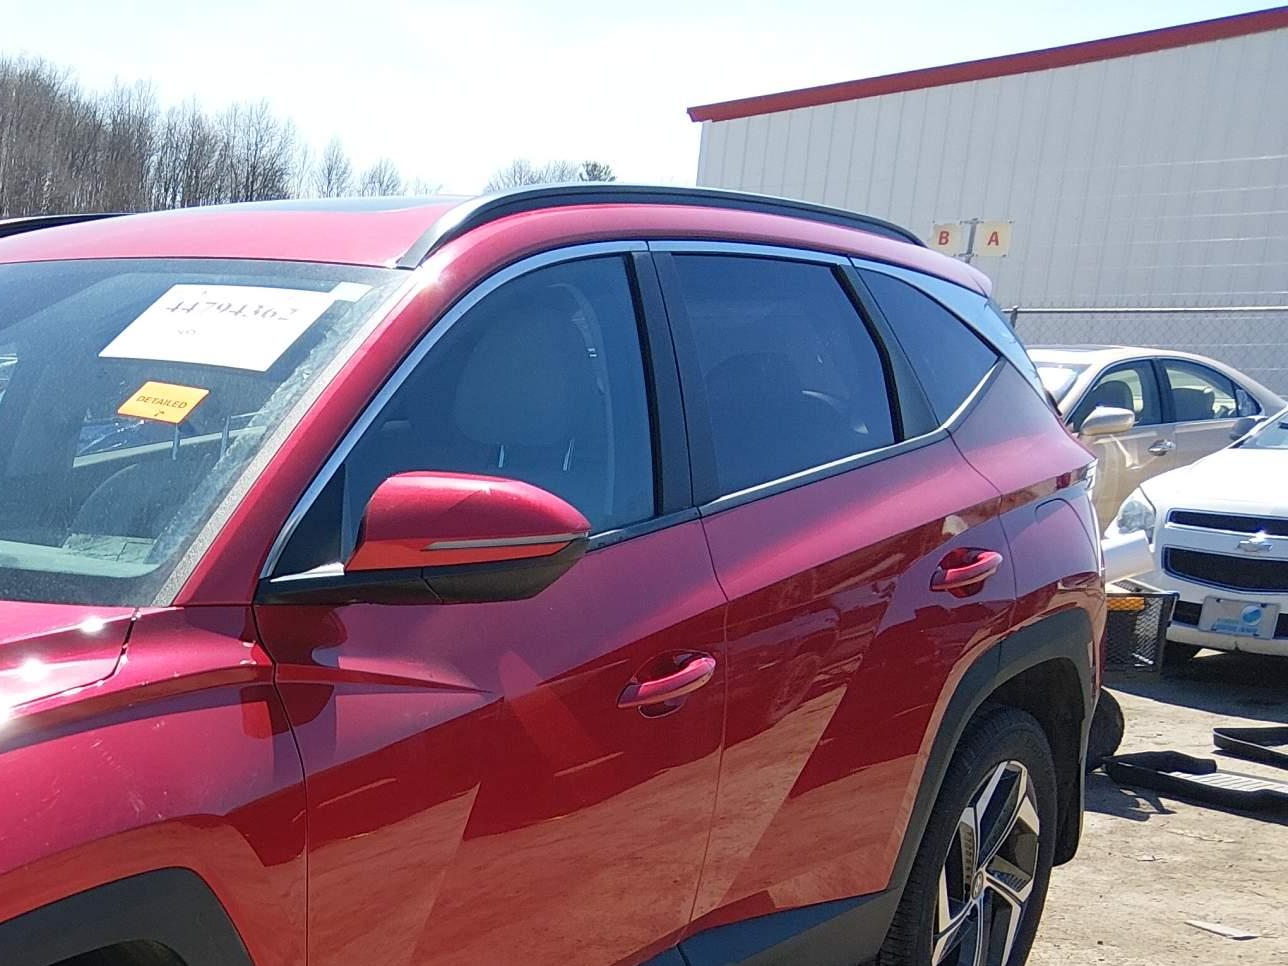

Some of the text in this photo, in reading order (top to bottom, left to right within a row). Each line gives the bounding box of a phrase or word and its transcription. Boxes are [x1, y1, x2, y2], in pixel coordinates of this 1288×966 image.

[938, 231, 950, 246] B
[987, 231, 1000, 246] A
[136, 395, 188, 409] DETAILED
